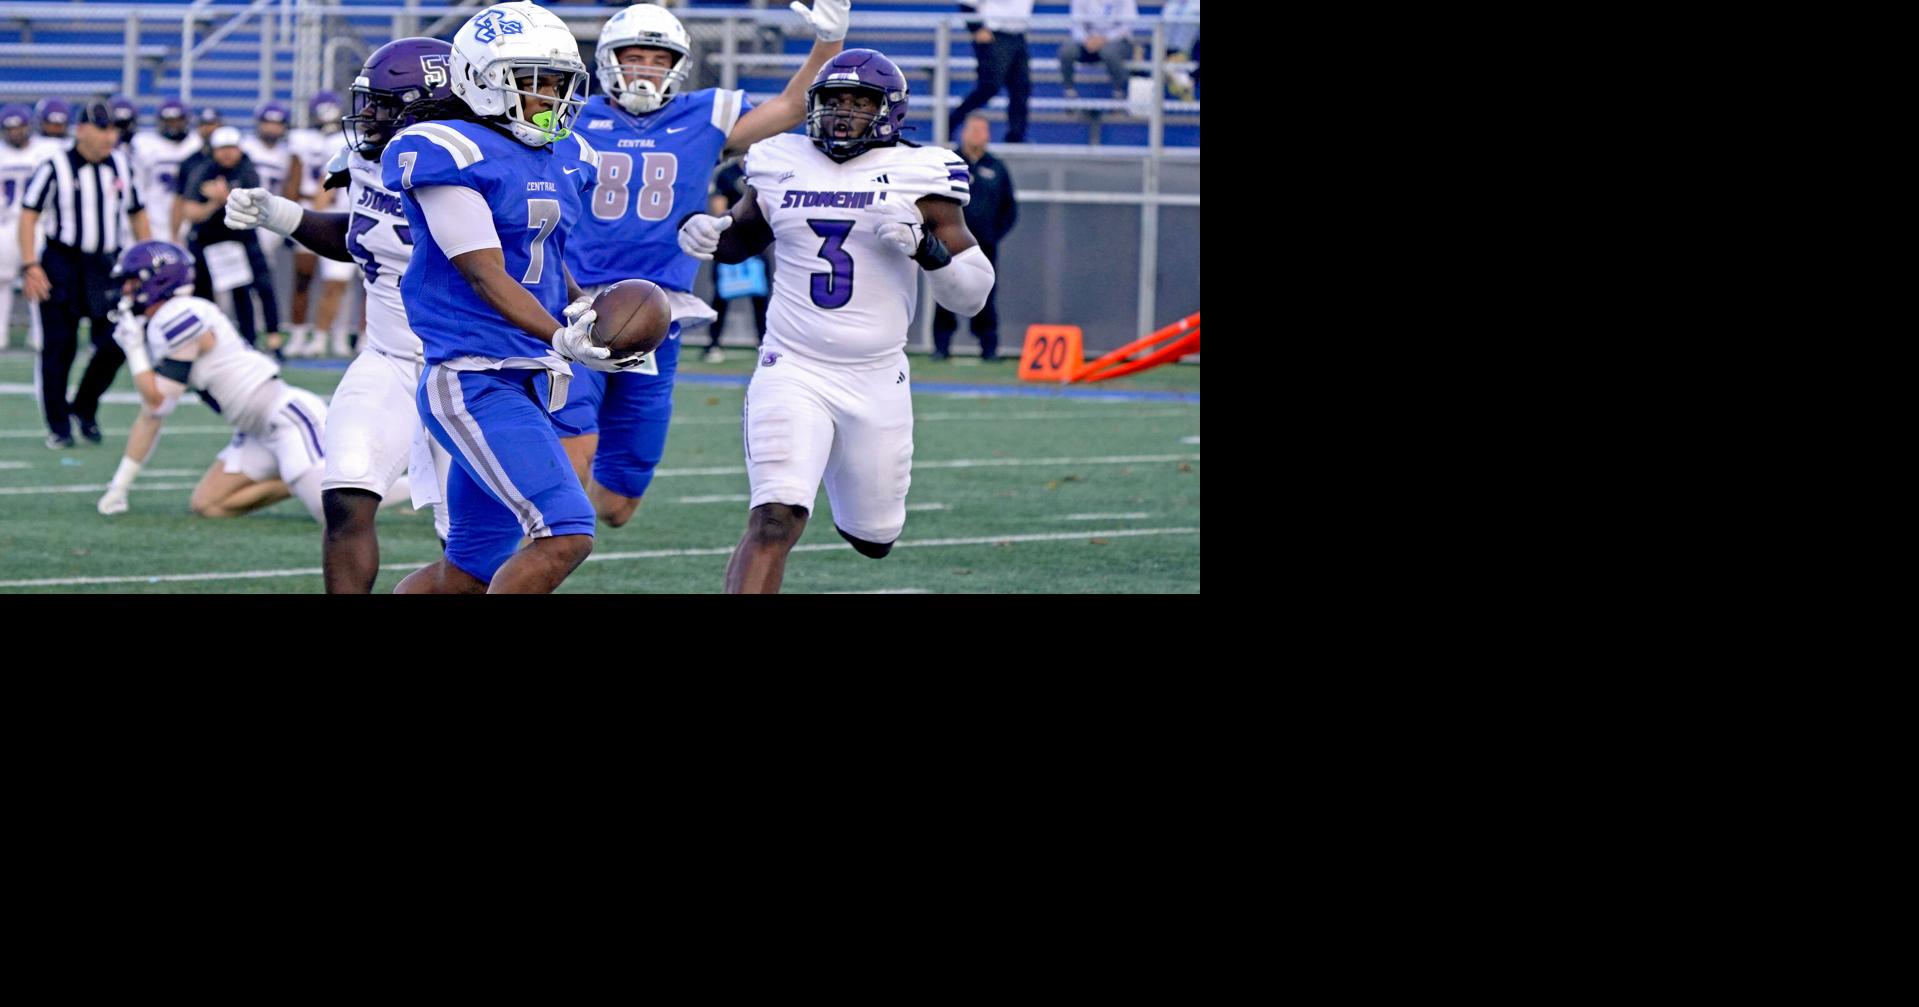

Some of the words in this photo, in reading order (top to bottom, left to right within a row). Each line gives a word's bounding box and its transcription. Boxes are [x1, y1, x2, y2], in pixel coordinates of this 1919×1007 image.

[398, 151, 417, 190] 7
[526, 181, 557, 192] CENTRAL
[591, 150, 678, 221] 88
[521, 199, 561, 284] 7
[806, 218, 856, 310] 3
[1030, 336, 1066, 369] 20
